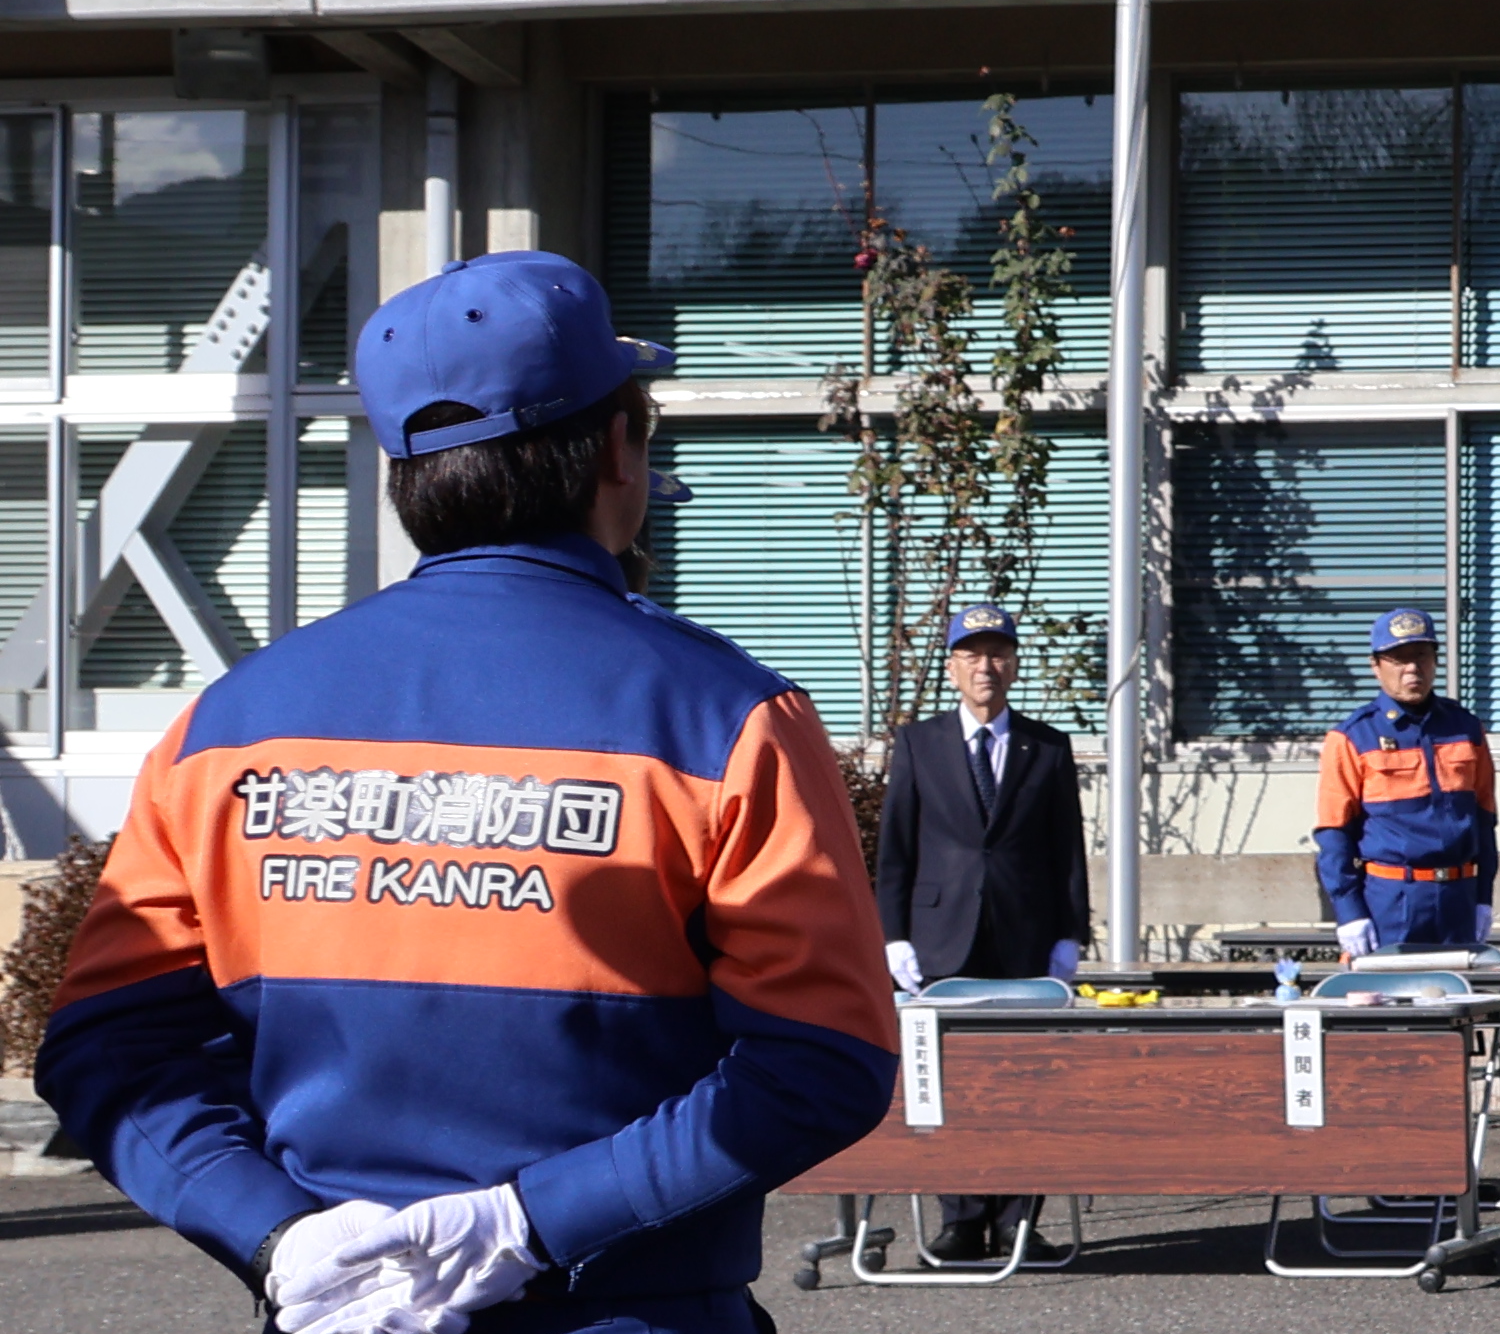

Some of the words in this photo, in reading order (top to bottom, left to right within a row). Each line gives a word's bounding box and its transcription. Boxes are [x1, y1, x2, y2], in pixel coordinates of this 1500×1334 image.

[238, 772, 620, 853] 甘楽町消防団
[263, 858, 358, 899] FIRE
[370, 861, 552, 910] KANRA
[1293, 1021, 1313, 1108] 検閲者
